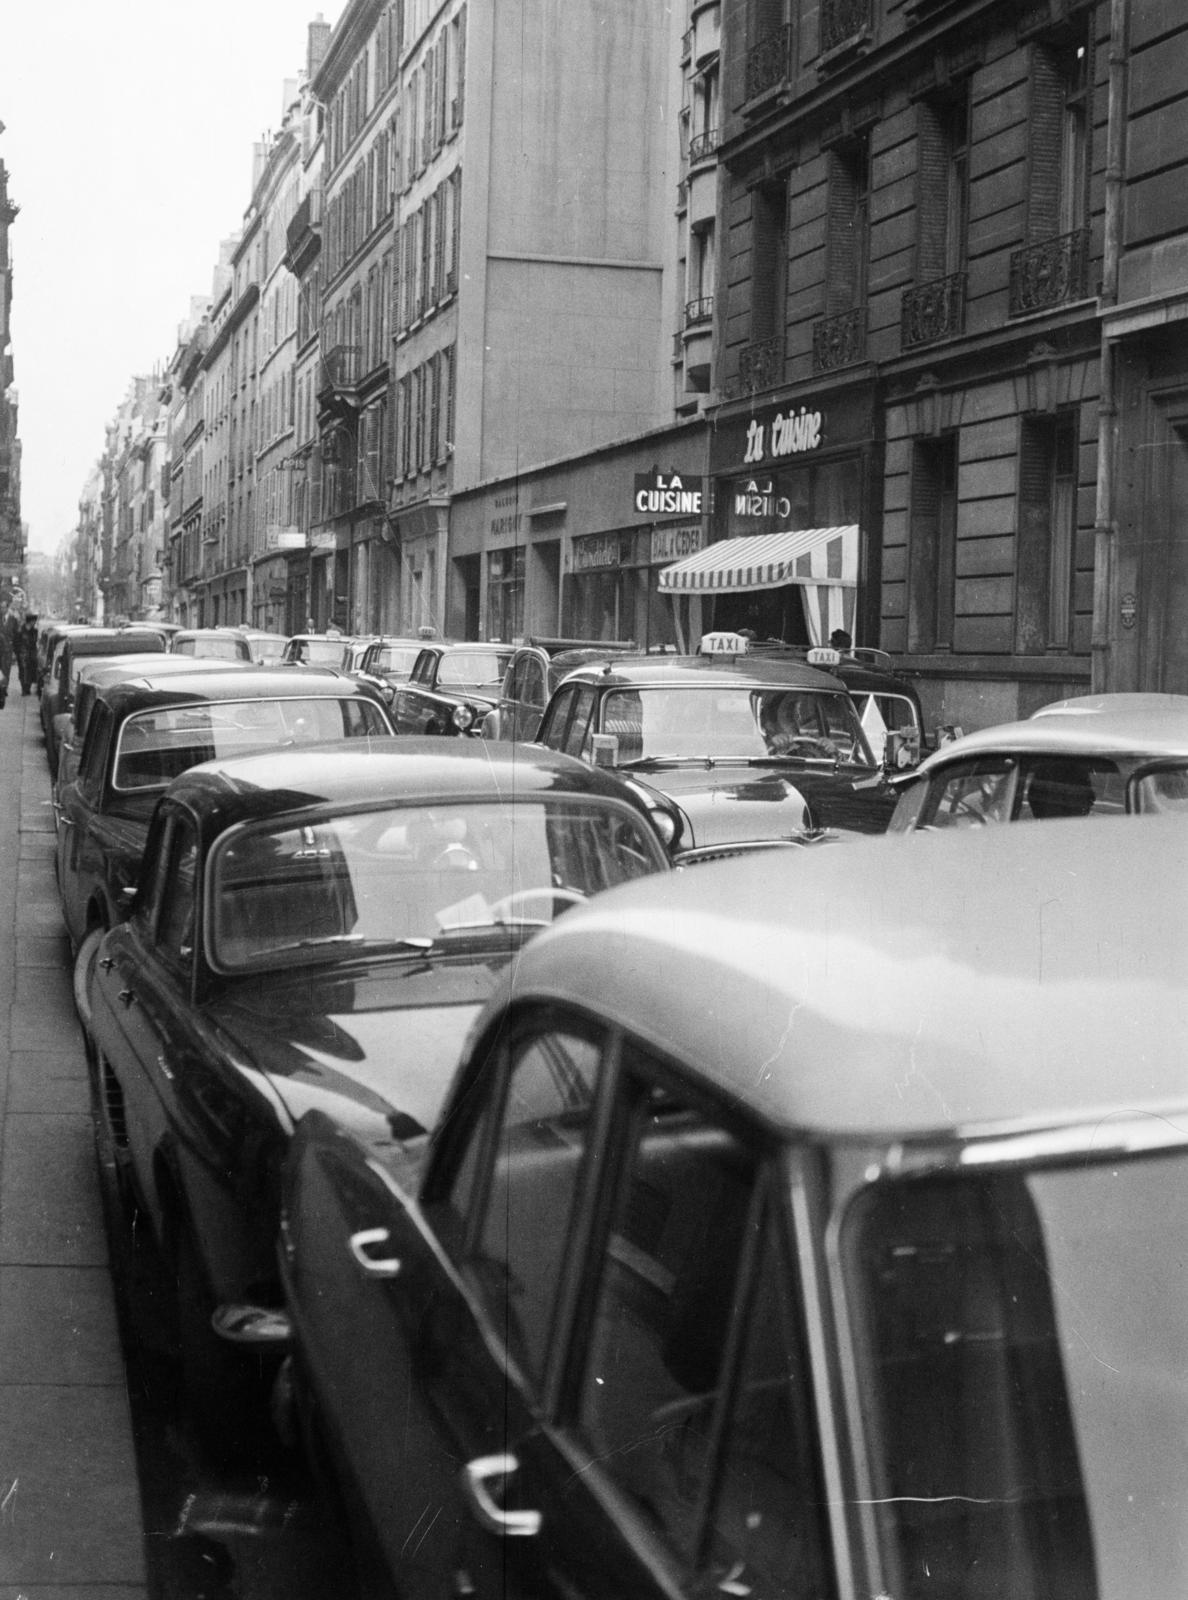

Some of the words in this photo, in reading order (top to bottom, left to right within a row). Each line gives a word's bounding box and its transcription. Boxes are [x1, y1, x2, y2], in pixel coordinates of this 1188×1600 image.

[771, 405, 822, 457] Cuisine
[656, 474, 683, 489] LA
[635, 489, 702, 514] CUISINE
[709, 638, 739, 651] TAXI
[813, 652, 836, 662] TAXI
